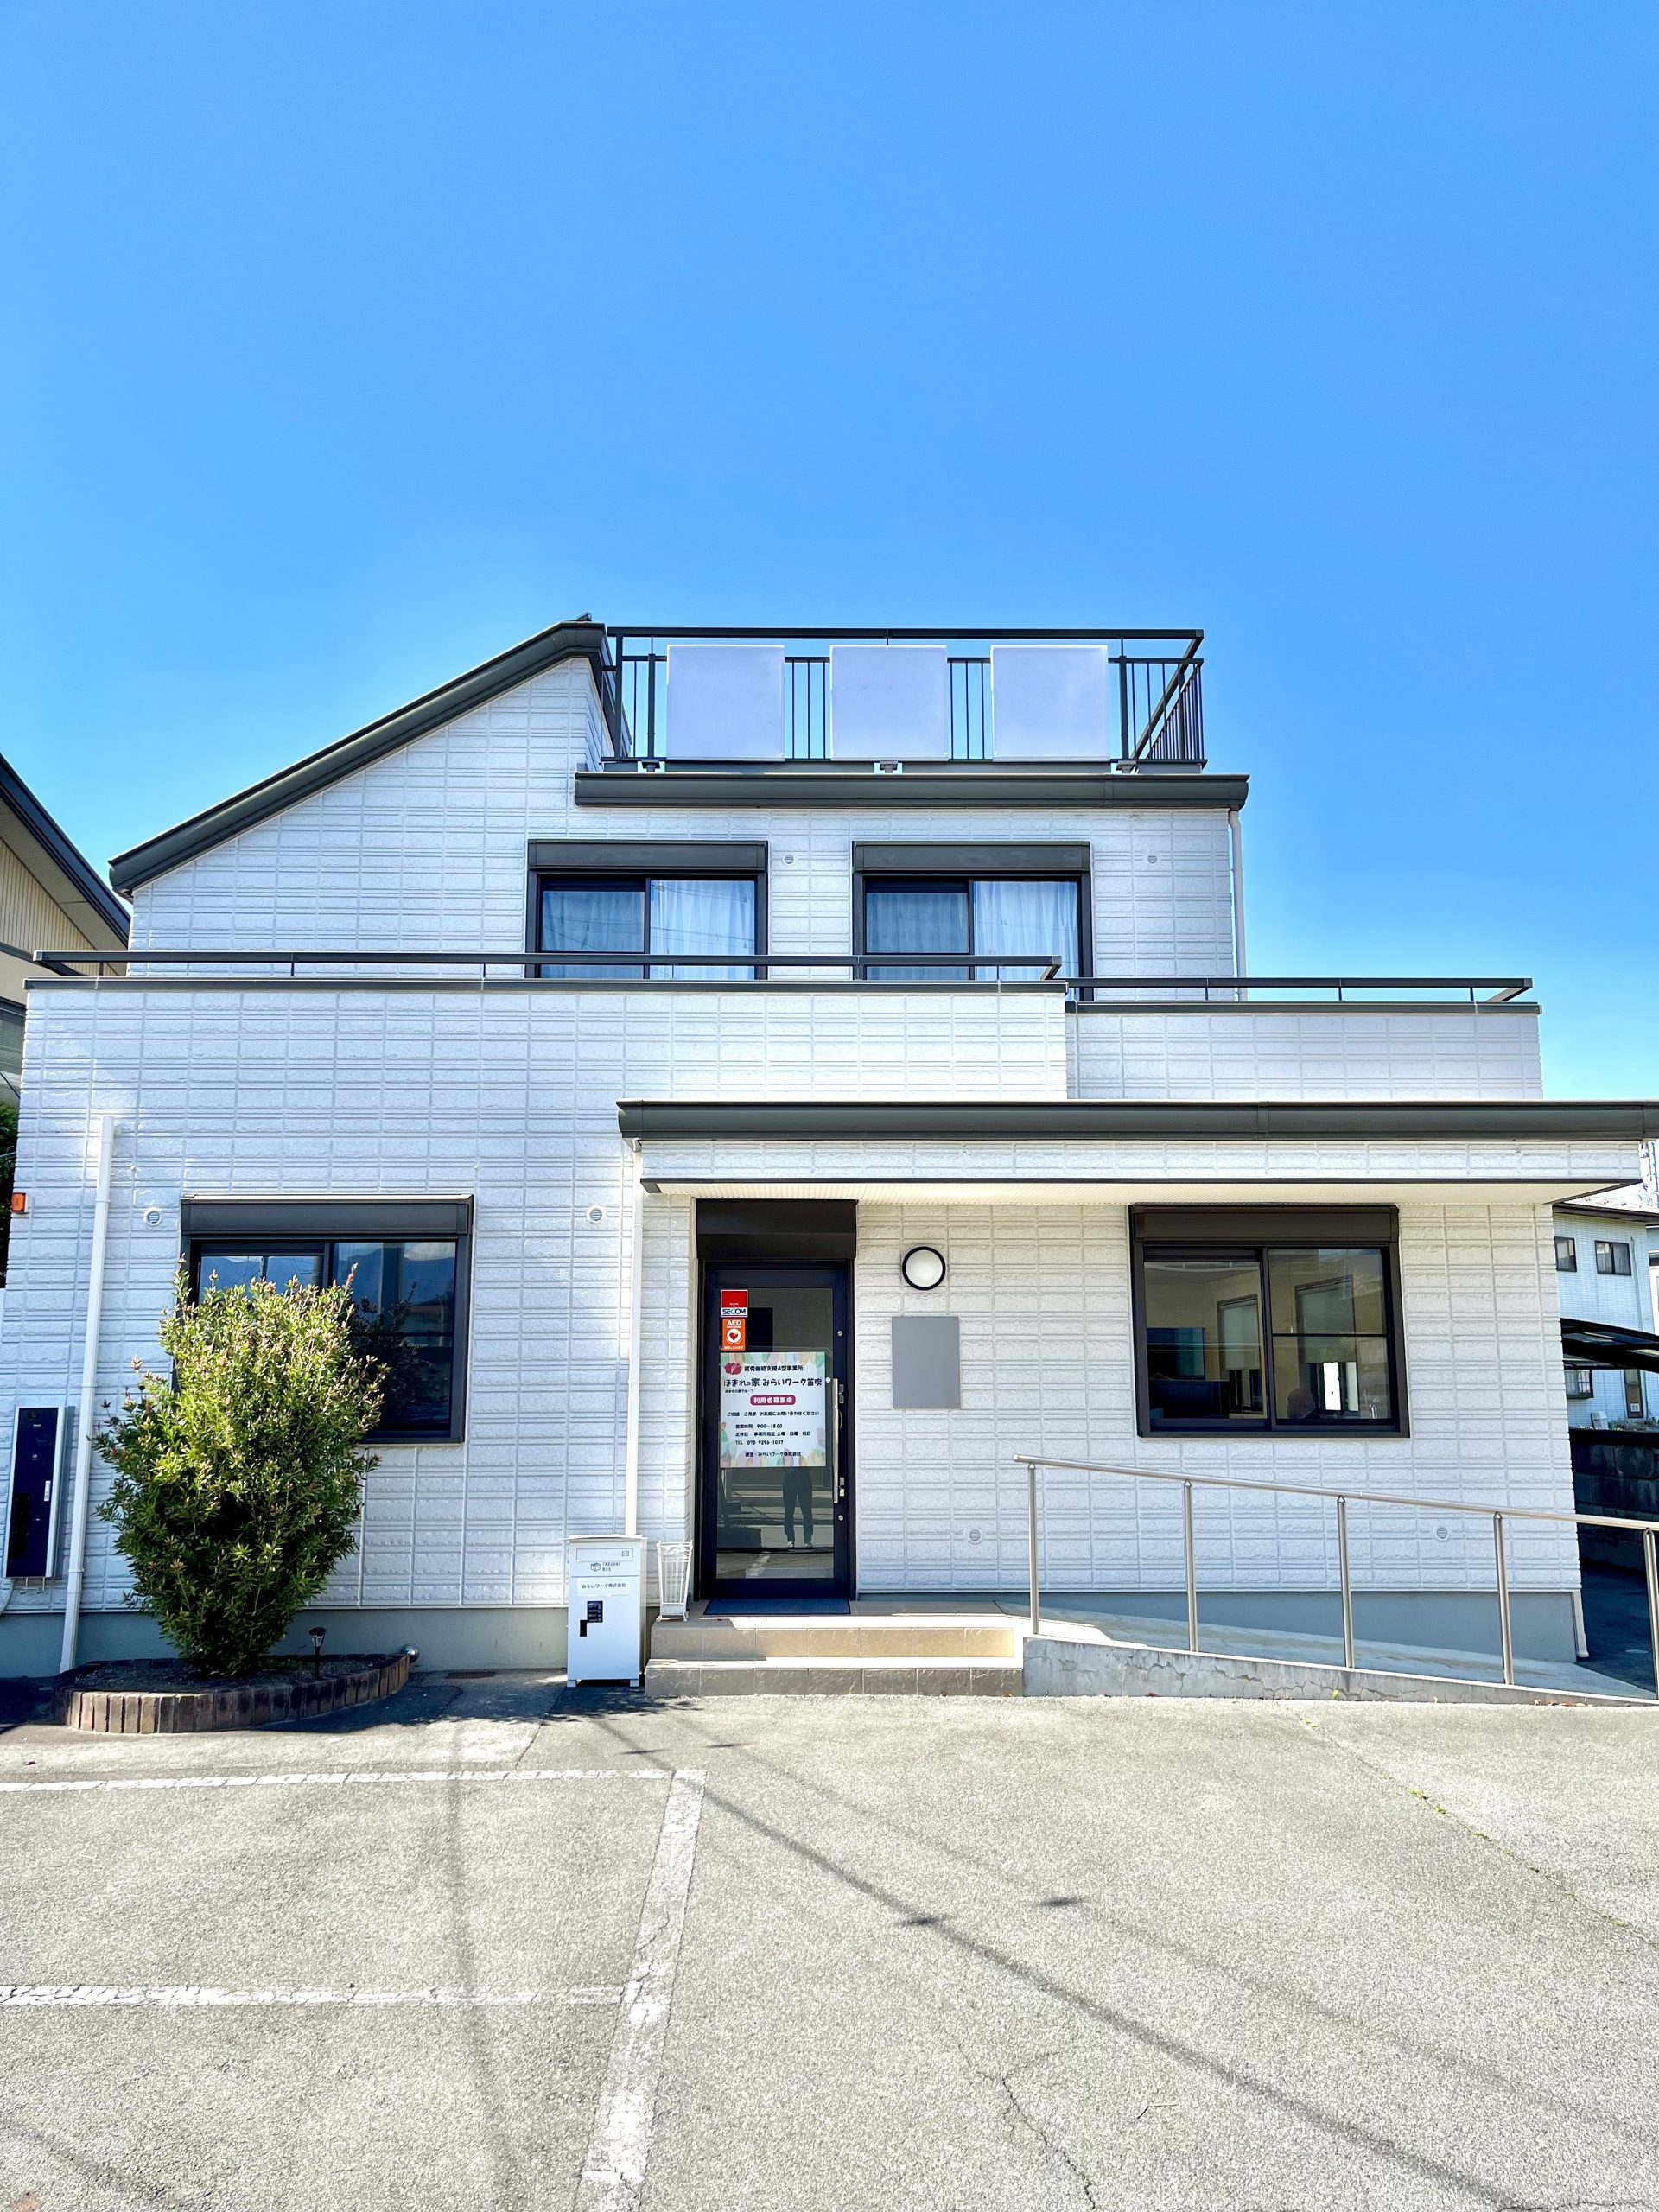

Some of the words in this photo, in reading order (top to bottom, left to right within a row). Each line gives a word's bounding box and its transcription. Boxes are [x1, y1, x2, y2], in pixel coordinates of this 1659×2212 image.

[723, 1378, 760, 1387] ほまれの家
[762, 1377, 823, 1387] みらいワーク笛吹
